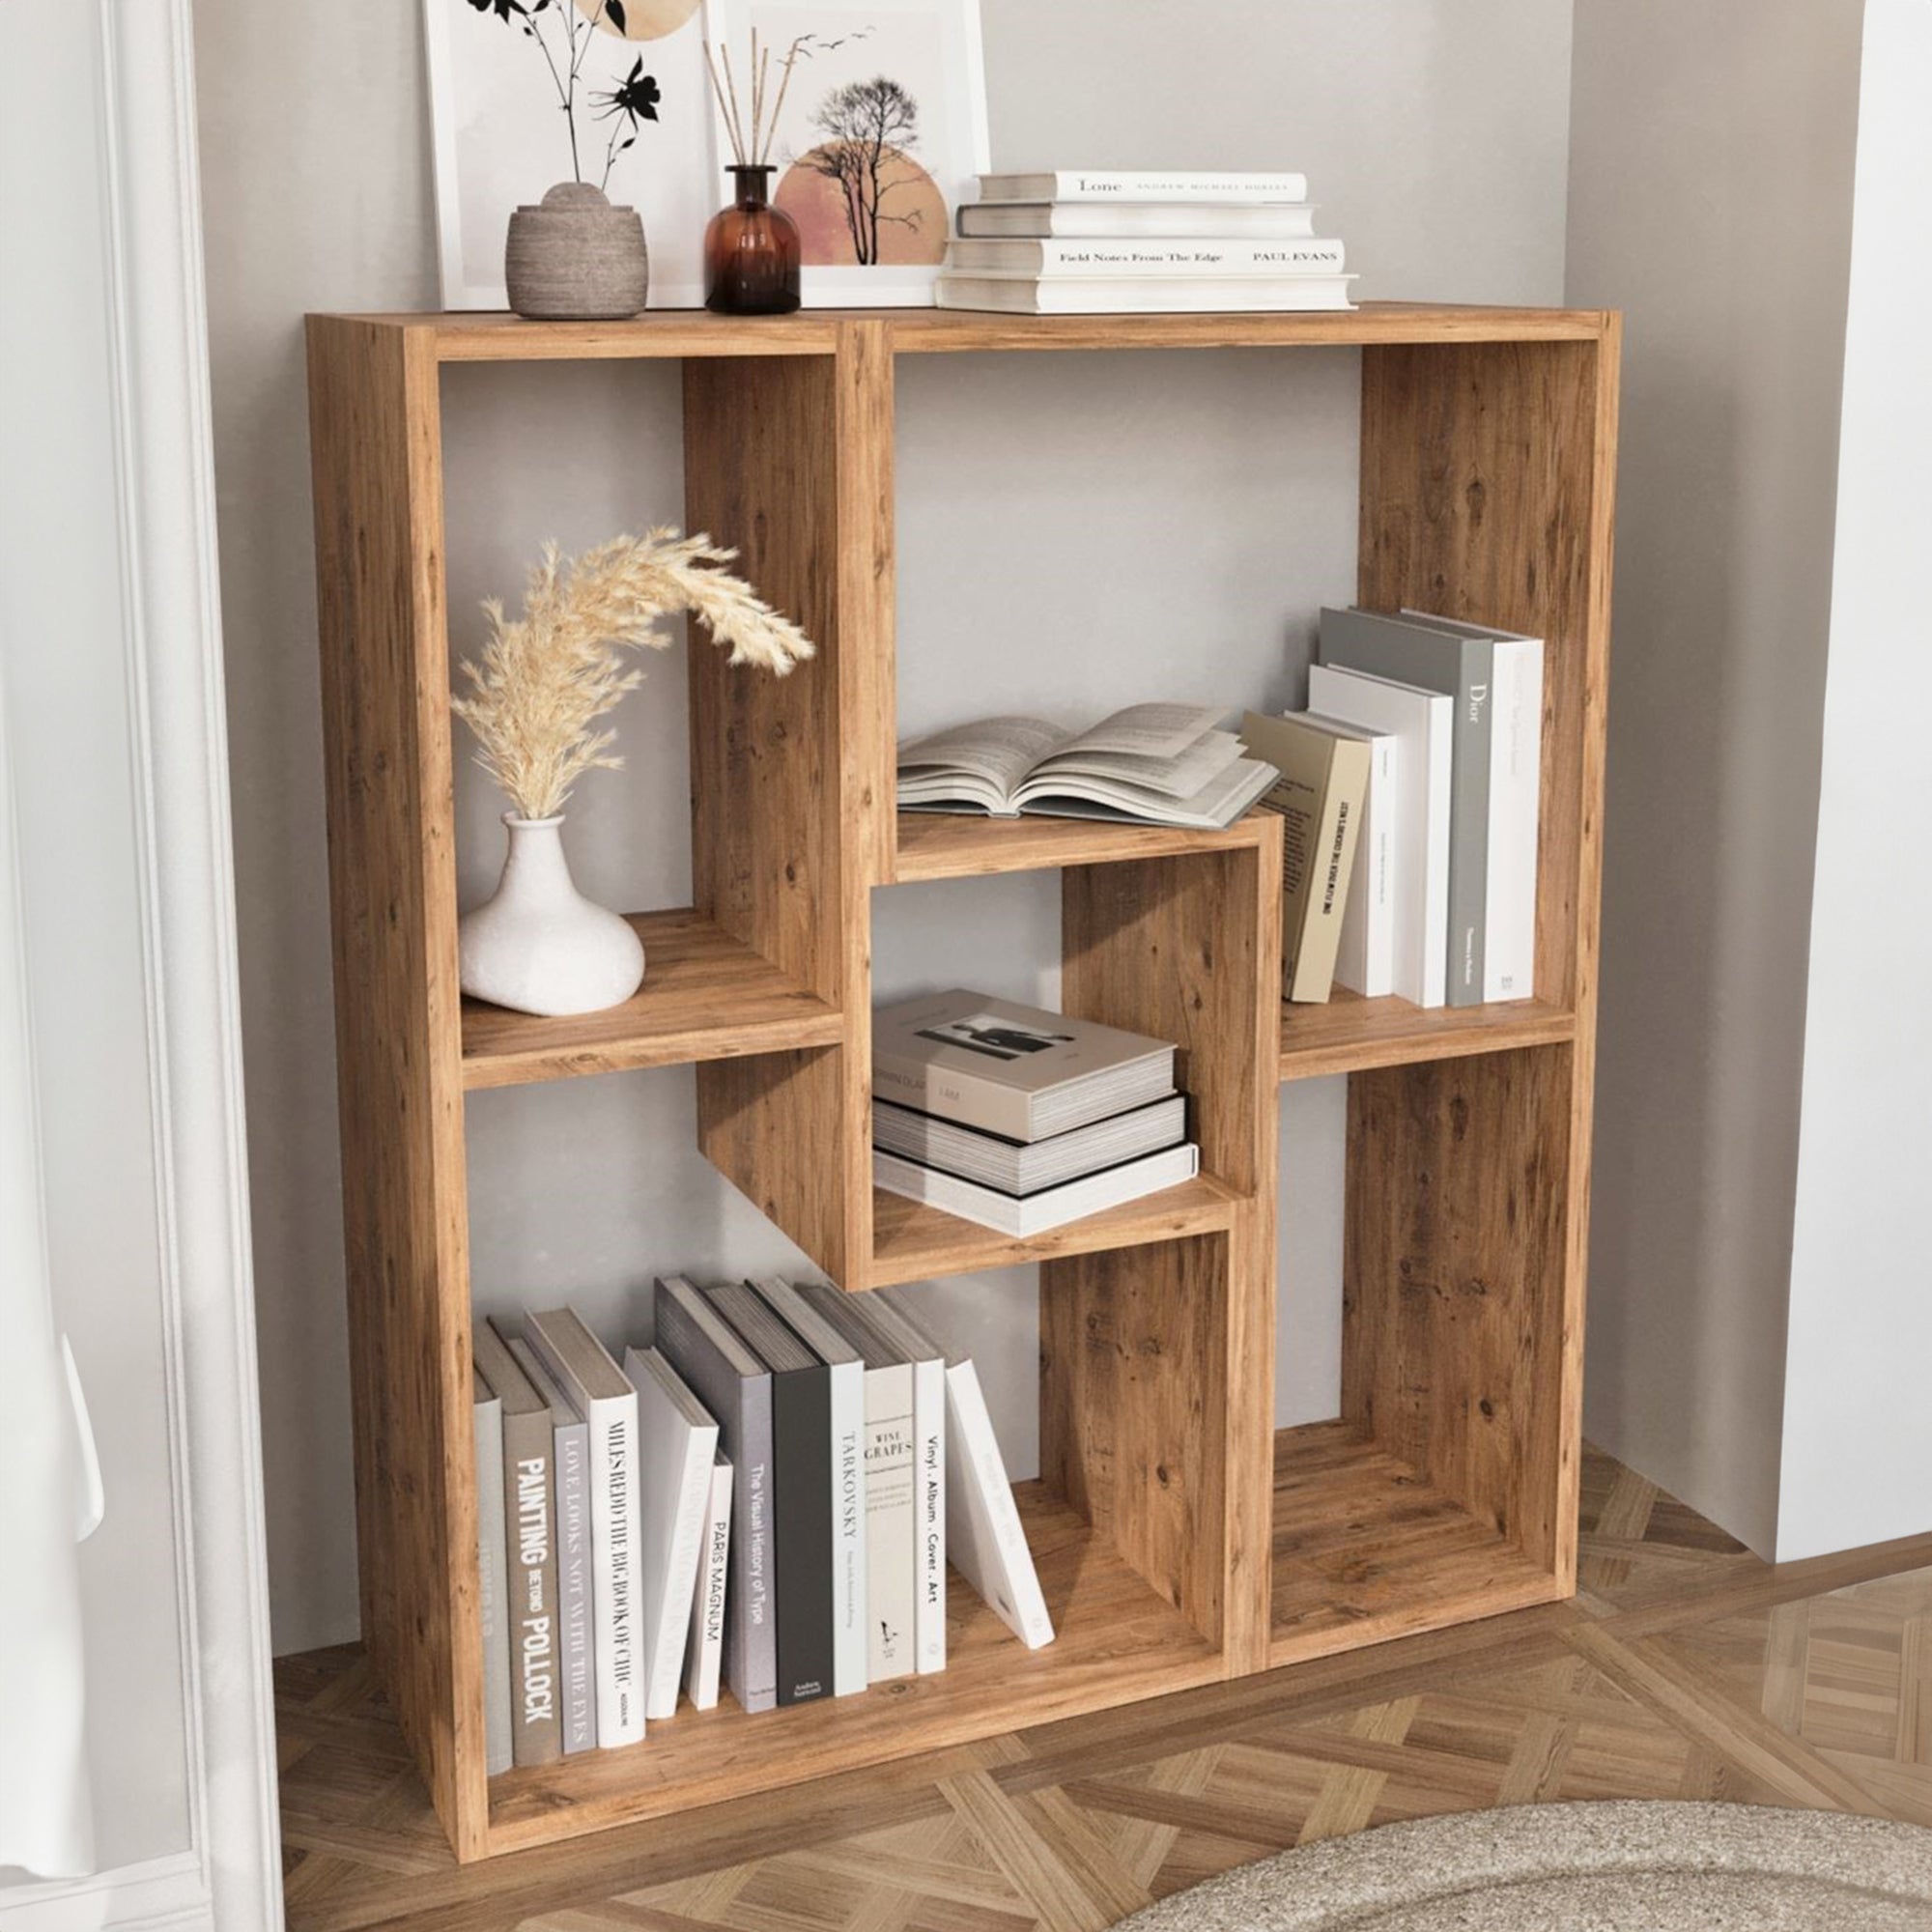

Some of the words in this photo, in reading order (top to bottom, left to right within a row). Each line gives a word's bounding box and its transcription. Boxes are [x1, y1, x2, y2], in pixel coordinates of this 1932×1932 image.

[1079, 178, 1122, 192] Lone
[1060, 253, 1091, 262] Field
[1094, 253, 1128, 262] Notes
[1131, 253, 1164, 262] From
[1168, 253, 1190, 262] The
[1194, 253, 1223, 263] Edge
[1253, 252, 1290, 261] PAUL
[1293, 252, 1337, 261] EVANS
[1469, 683, 1487, 724] Dior
[608, 1420, 626, 1469] MILES
[865, 1442, 913, 1461] GRAPES
[874, 1431, 901, 1443] WINE
[925, 1435, 938, 1469] Vinyl
[564, 1439, 581, 1488] LOVE
[751, 1463, 765, 1486] The
[610, 1470, 627, 1514] REDD
[841, 1431, 857, 1538] TARKOVSKY
[927, 1480, 938, 1523] Album
[518, 1458, 547, 1565] PAINTING
[566, 1492, 582, 1553] LOOKS
[751, 1489, 765, 1531] Visual
[611, 1518, 628, 1549] THE
[711, 1521, 726, 1565] PARIS
[927, 1533, 939, 1571] Cover
[611, 1551, 628, 1579] BIG
[750, 1532, 765, 1579] History
[568, 1558, 583, 1595] NOT
[753, 1580, 766, 1594] of
[927, 1581, 939, 1604] Art
[612, 1581, 630, 1625] BOOK
[706, 1568, 724, 1642] MAGNUM
[751, 1596, 767, 1625] Type
[570, 1602, 585, 1653] WITH
[613, 1626, 630, 1645] OF
[523, 1616, 553, 1723] POLLOCK
[571, 1658, 586, 1696] THE
[614, 1650, 631, 1689] CHIC
[573, 1699, 587, 1745] EYES
